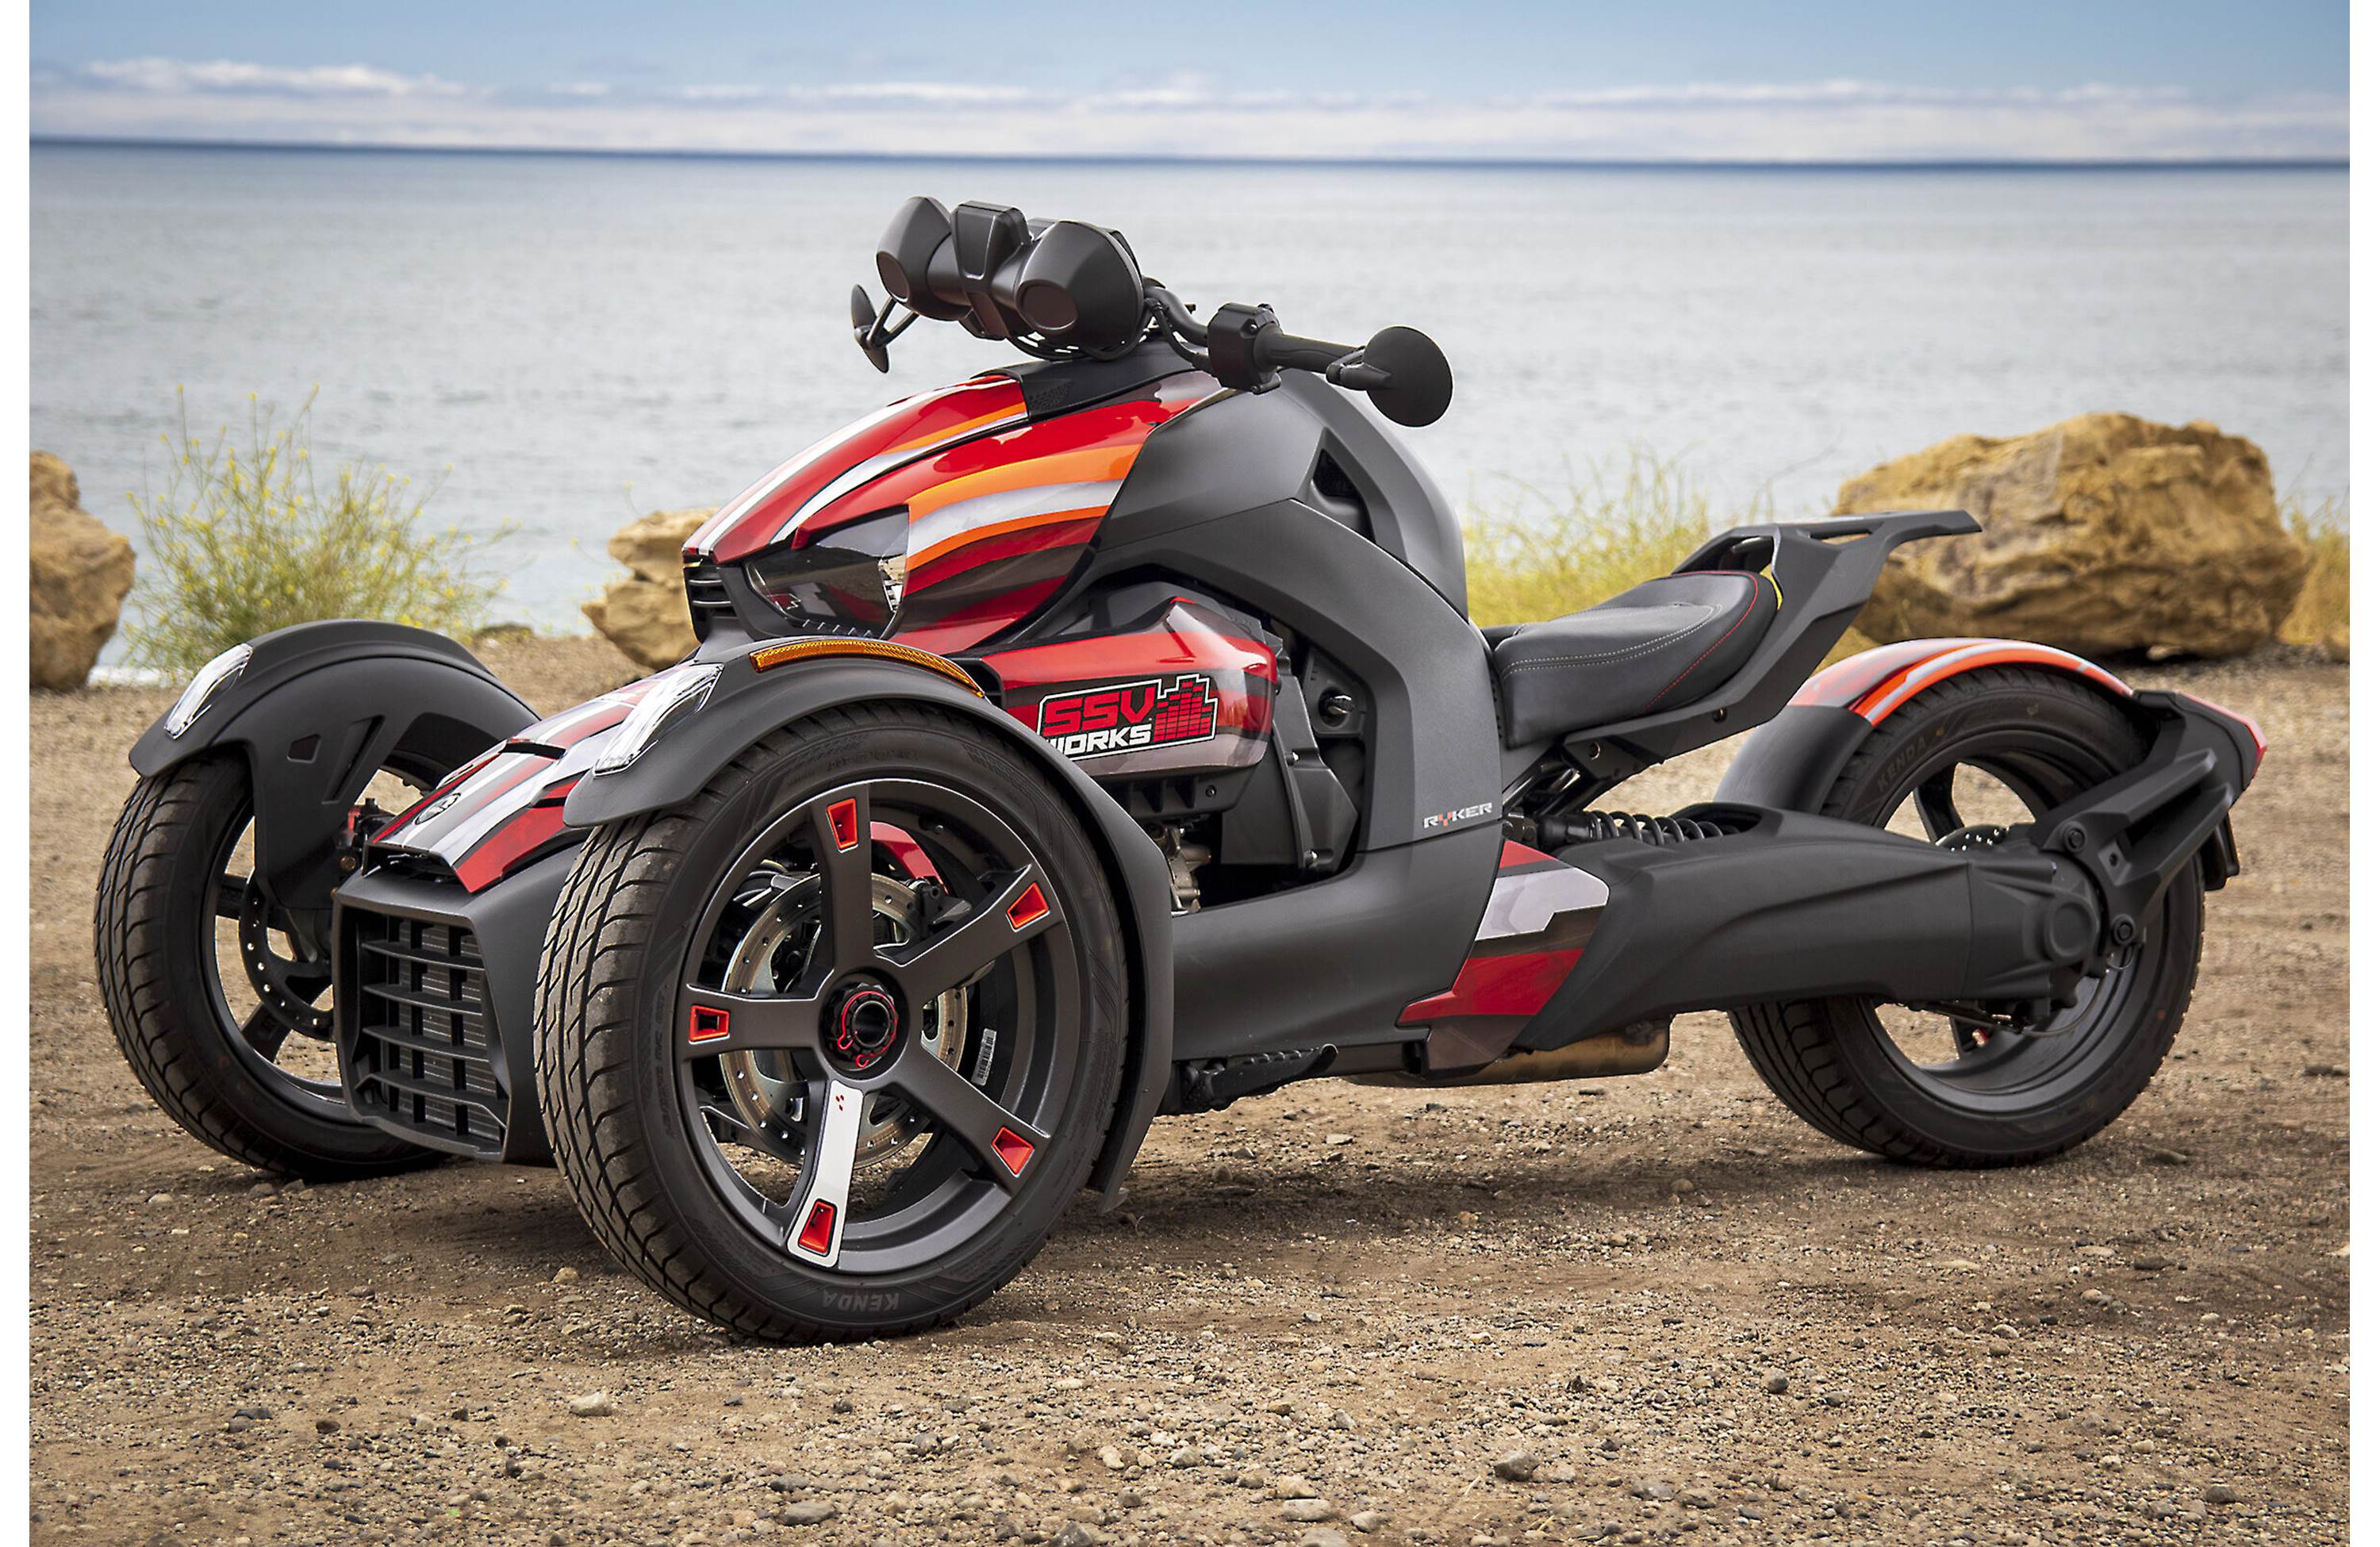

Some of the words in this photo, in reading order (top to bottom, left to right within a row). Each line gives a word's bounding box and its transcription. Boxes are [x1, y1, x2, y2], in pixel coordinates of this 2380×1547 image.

[1043, 686, 1156, 736] SSV
[1877, 736, 1927, 792] KENDA
[1423, 802, 1492, 828] RYKER
[823, 1288, 900, 1311] KENDA
